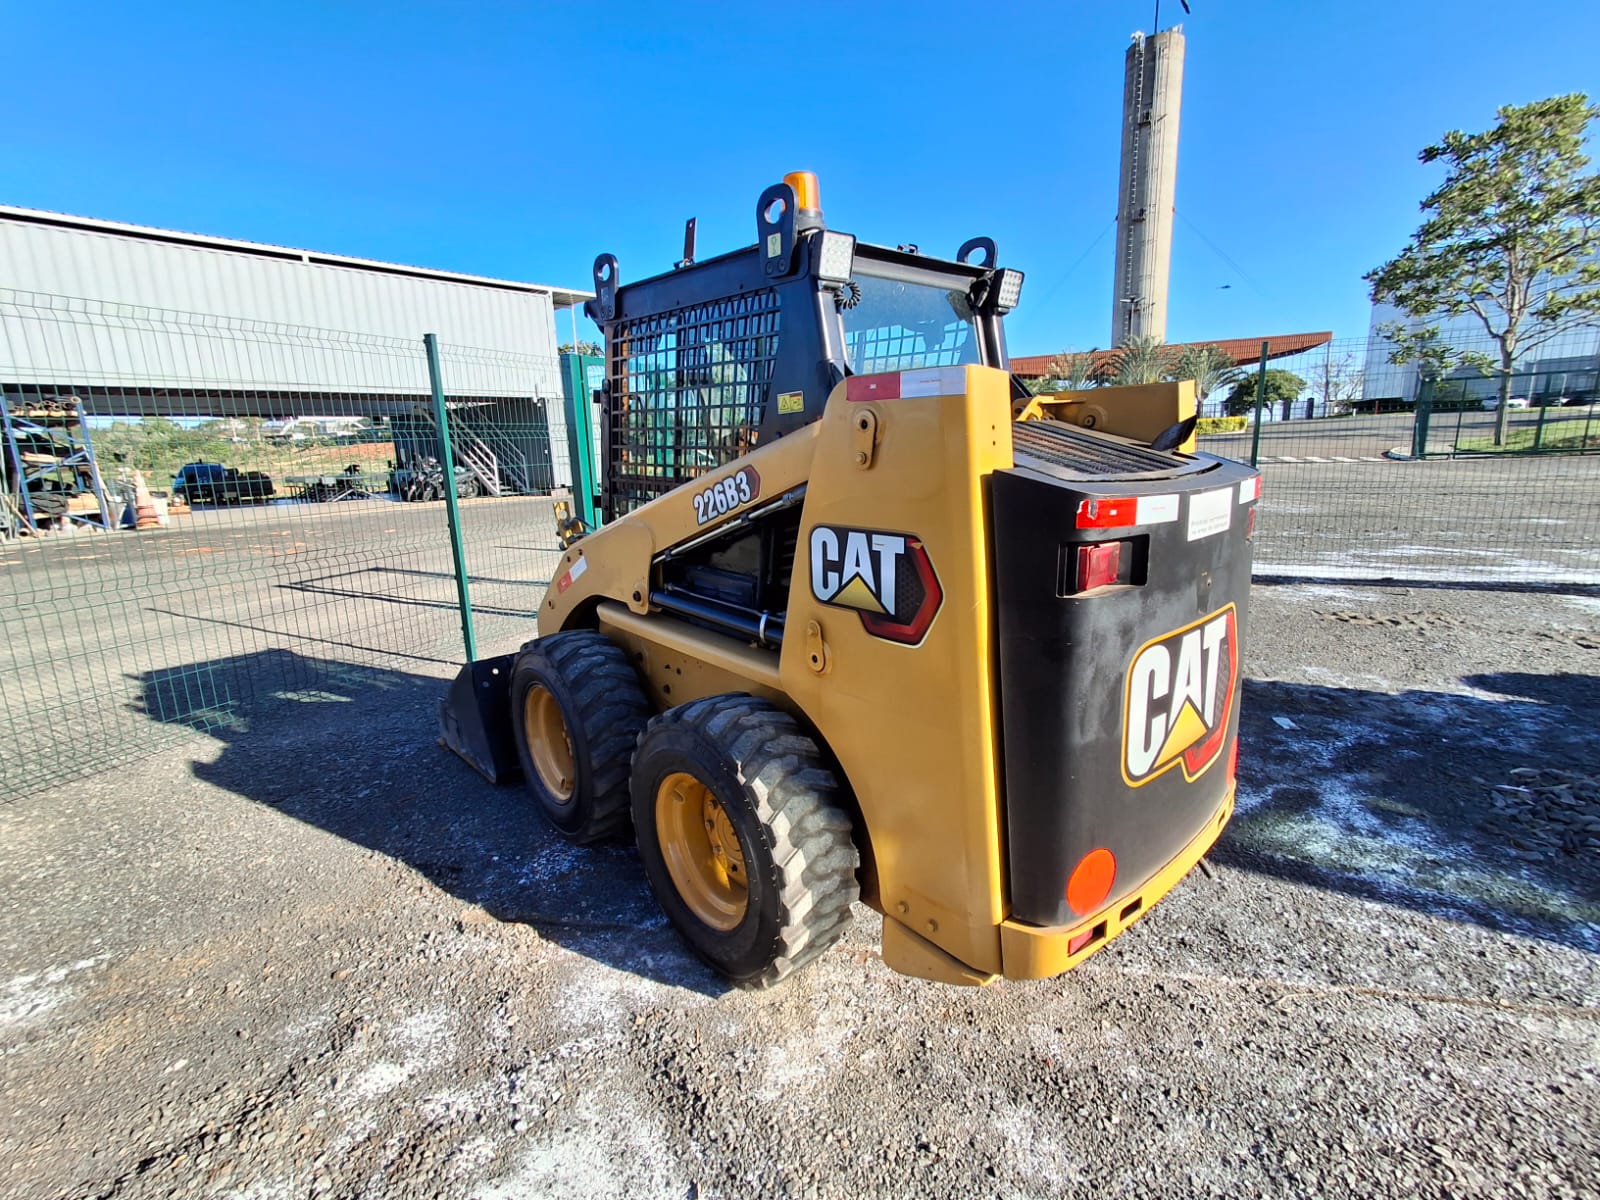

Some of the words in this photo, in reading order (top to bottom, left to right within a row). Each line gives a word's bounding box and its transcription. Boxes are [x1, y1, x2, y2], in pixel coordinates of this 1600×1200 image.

[694, 470, 751, 525] 226B3
[811, 527, 905, 616] CAT
[1127, 614, 1227, 777] CAT
